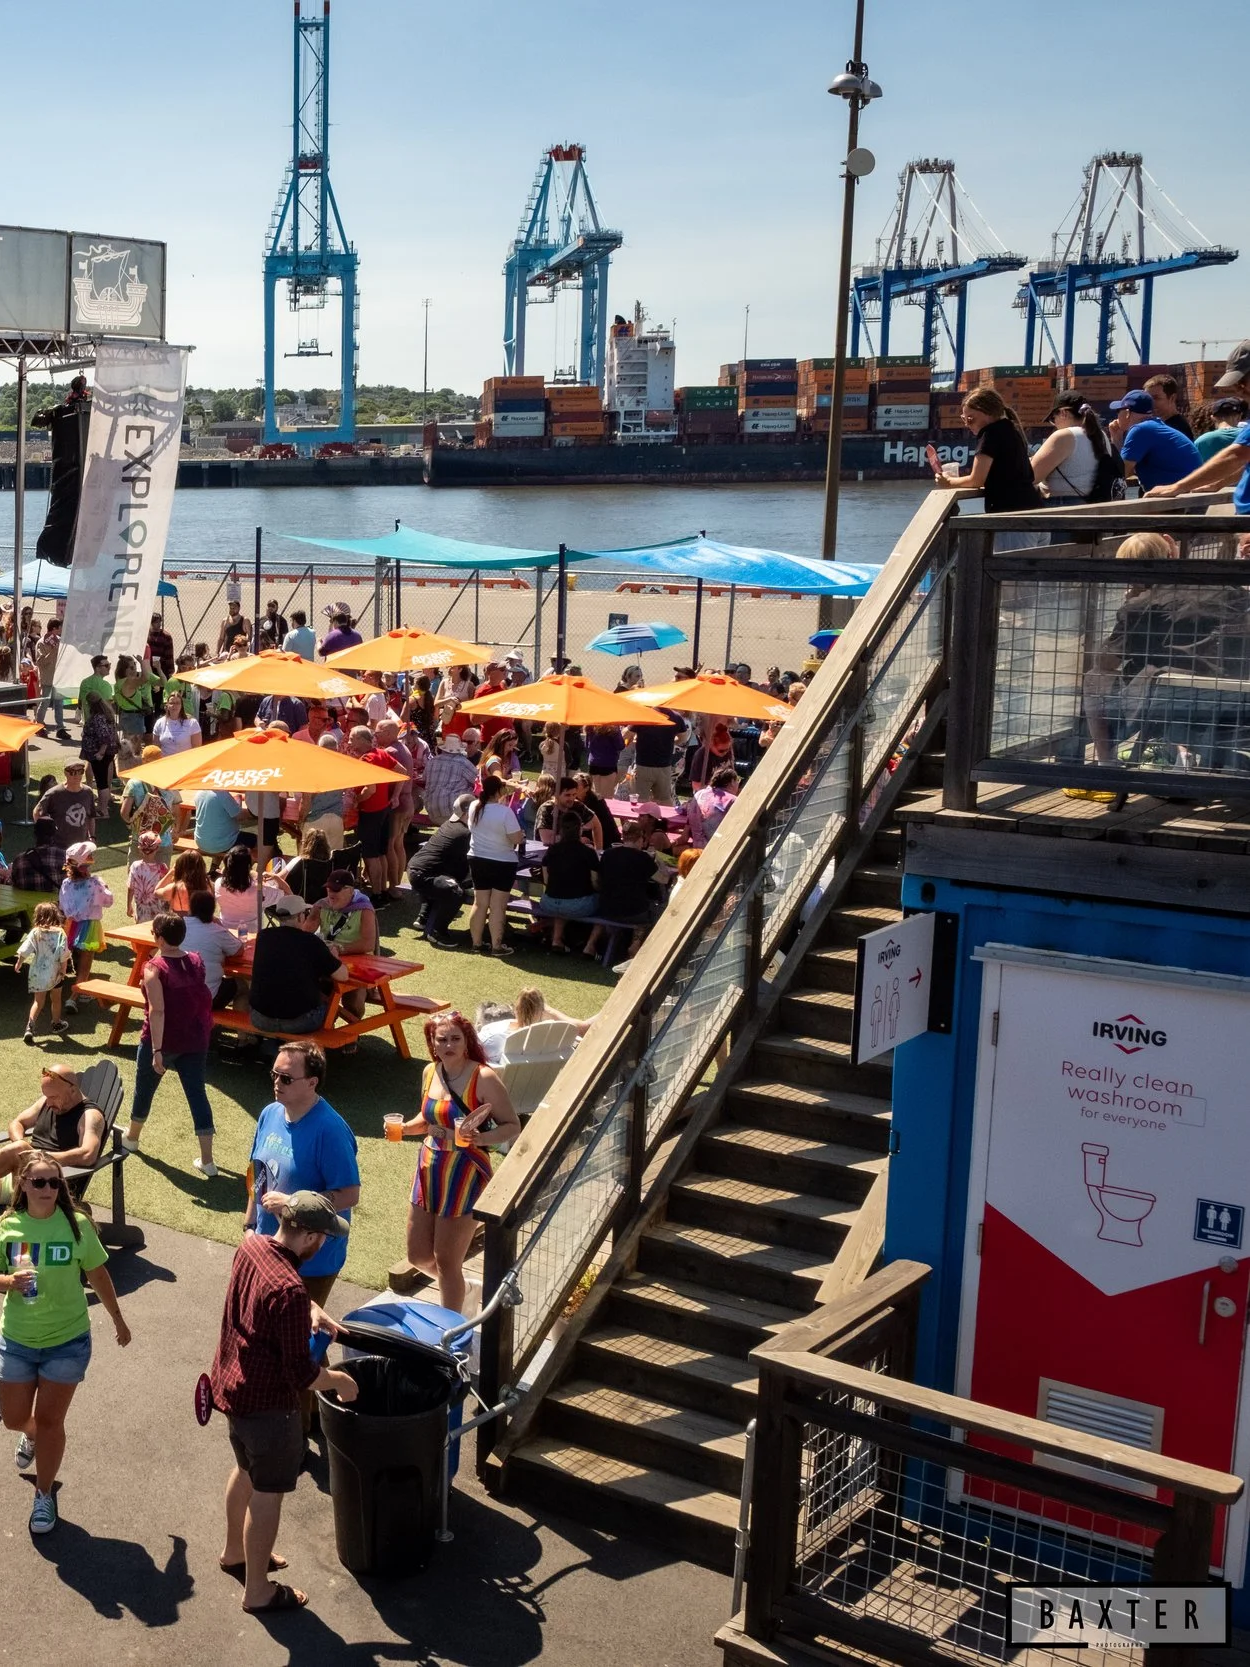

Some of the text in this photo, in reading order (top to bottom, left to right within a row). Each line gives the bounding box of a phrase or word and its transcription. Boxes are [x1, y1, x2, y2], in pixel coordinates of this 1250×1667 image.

[202, 767, 283, 783] APEROL
[213, 777, 269, 788] SPRITZ
[878, 945, 901, 964] IRVING
[1092, 1021, 1167, 1047] IRVING
[1062, 1060, 1193, 1097] Really clean
[1068, 1086, 1183, 1117] washroom
[1081, 1106, 1166, 1131] for everyone
[48, 1245, 71, 1262] TD
